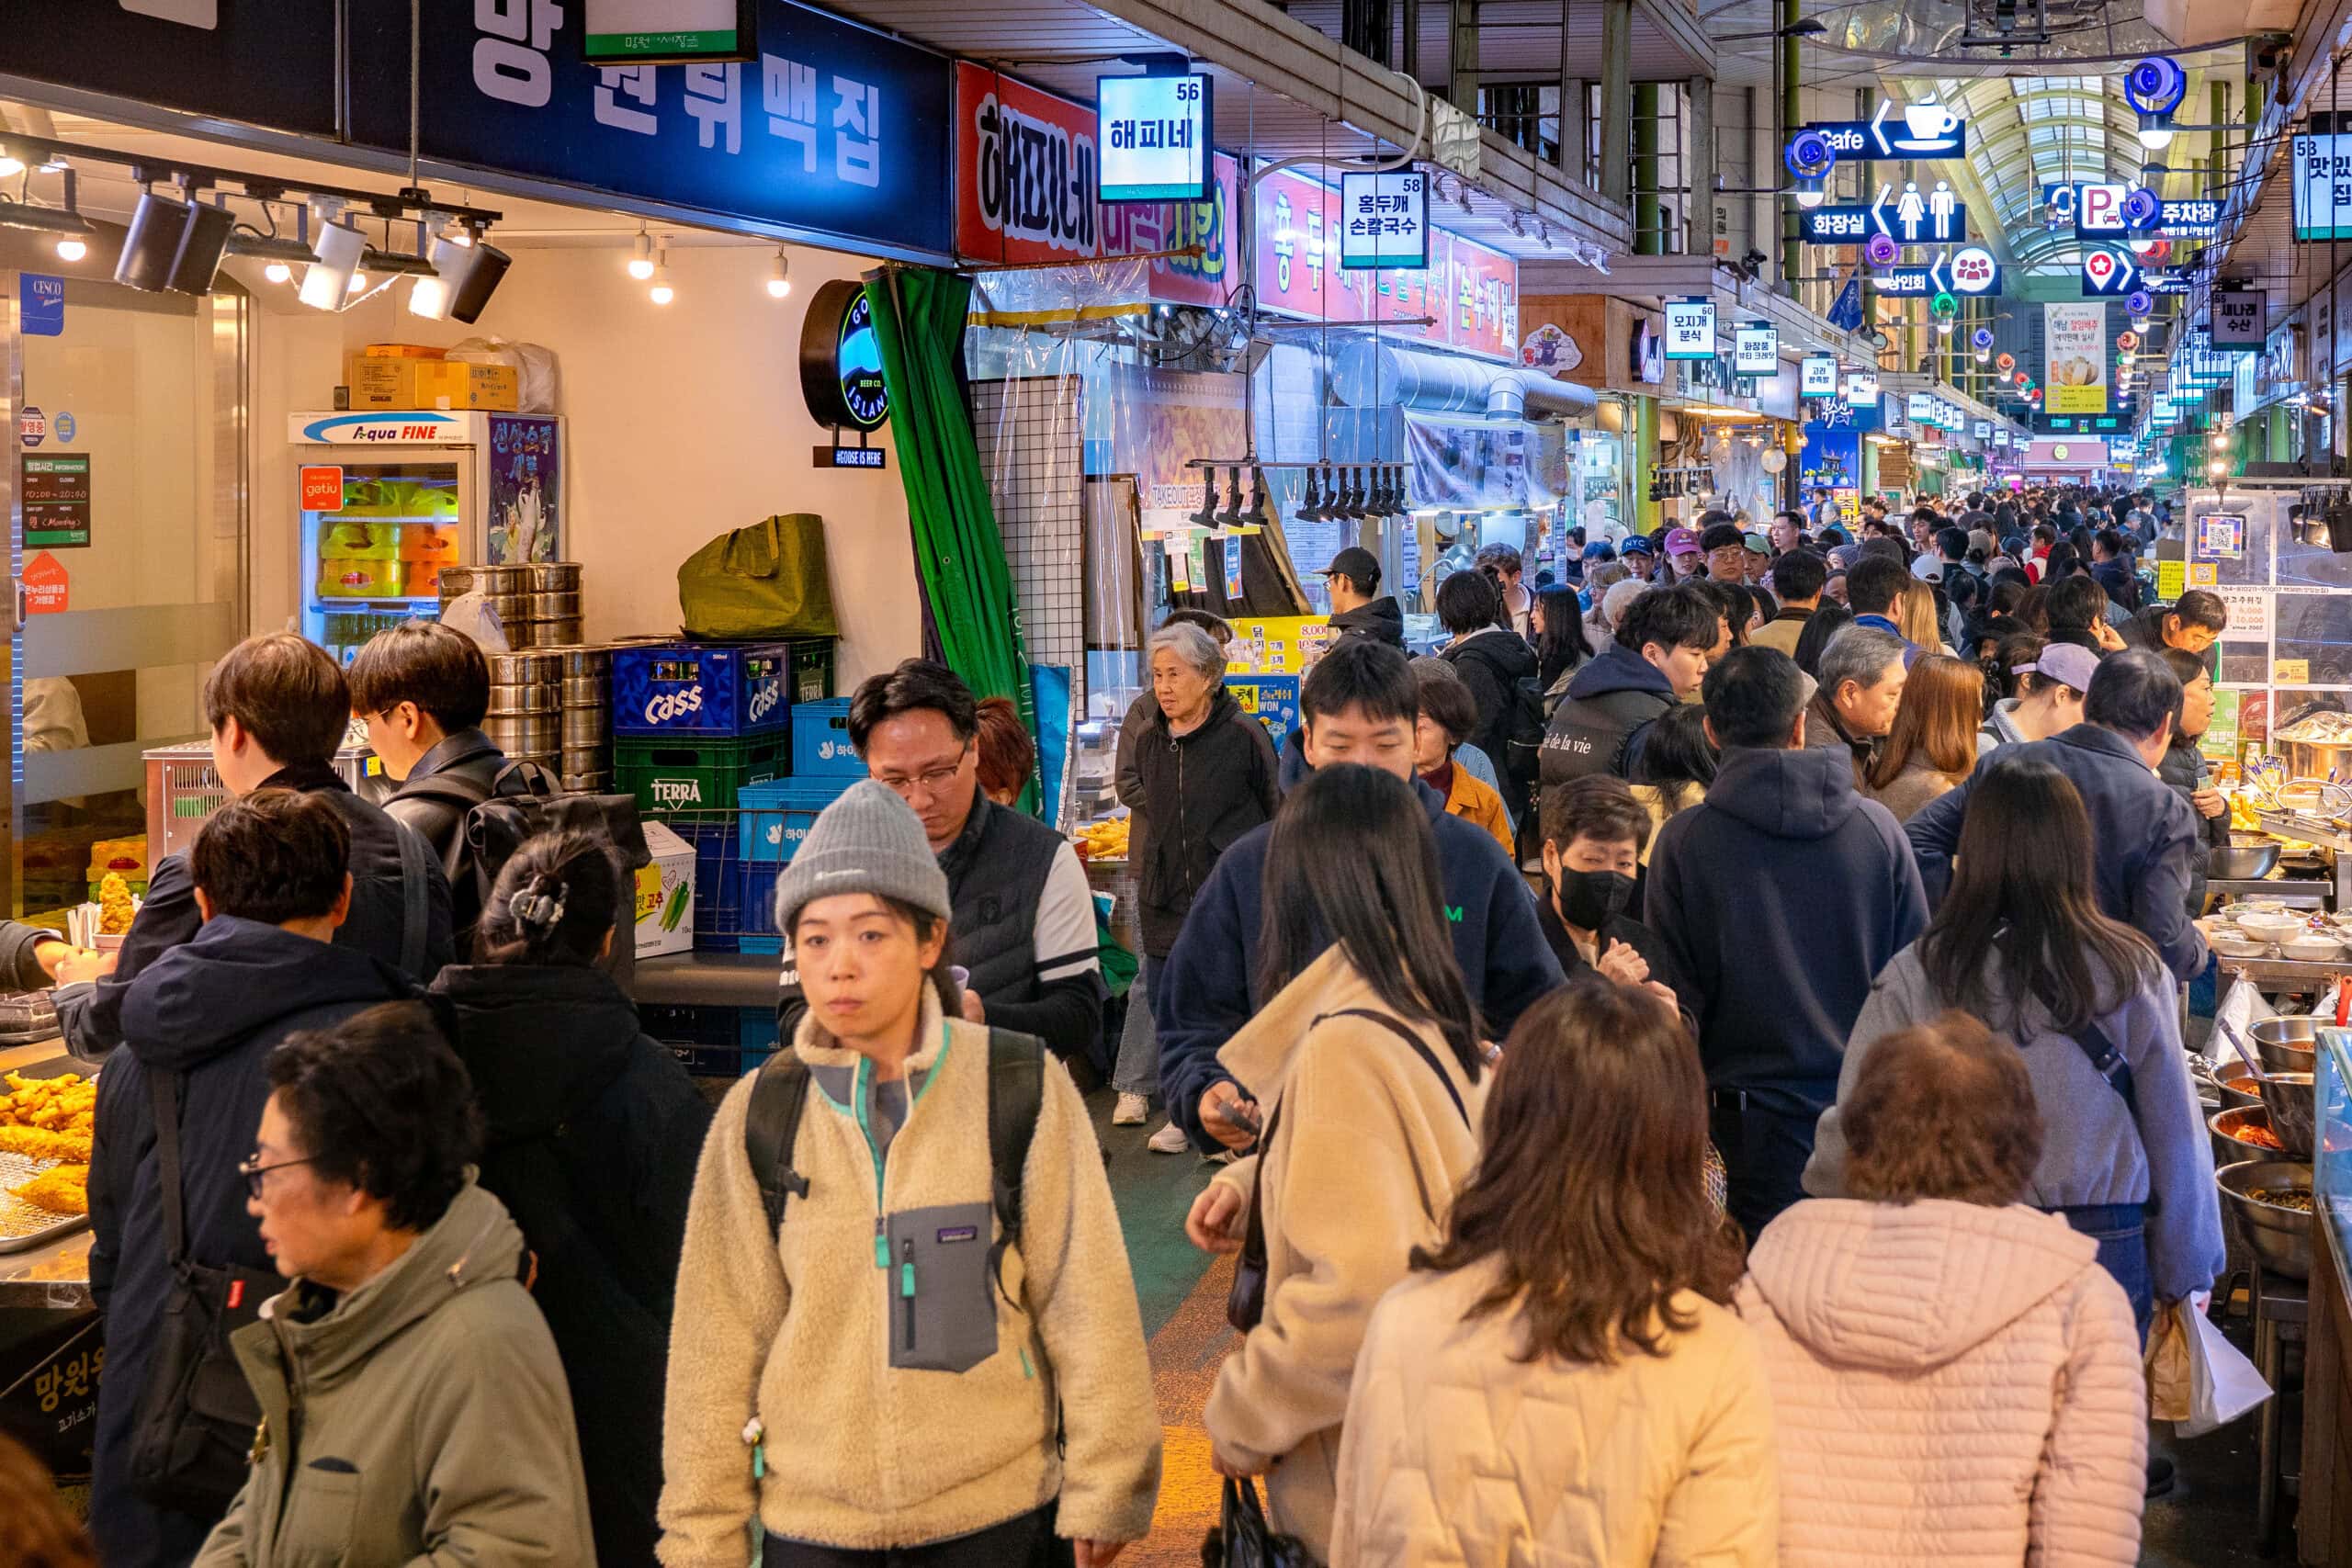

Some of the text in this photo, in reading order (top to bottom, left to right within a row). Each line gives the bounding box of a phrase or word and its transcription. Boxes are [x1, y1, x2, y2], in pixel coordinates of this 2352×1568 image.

[1177, 84, 1198, 100] 56
[1111, 119, 1193, 149] 해피네
[1818, 130, 1864, 150] Cafe
[980, 104, 1094, 248] 해피네
[1403, 179, 1420, 192] 58
[1358, 195, 1408, 212] 홍두깨
[2335, 184, 2351, 206] 집
[2088, 189, 2111, 224] P
[2162, 203, 2217, 223] 주차장
[1350, 218, 1417, 236] 손칼국수
[1814, 214, 1865, 234] 화장실
[33, 279, 62, 295] CESCO
[1888, 274, 1926, 290] 상인회
[1702, 307, 1713, 315] 60
[2221, 303, 2256, 316] 새나래
[2227, 321, 2251, 332] 수산
[1679, 331, 1701, 342] 분식
[1744, 342, 1770, 351] 화장품
[860, 378, 873, 389] BEER
[353, 425, 437, 441] Aqua FINE
[860, 451, 865, 465] IS
[866, 451, 881, 465] HERE
[1152, 485, 1187, 505] TAKEOUT
[799, 682, 823, 702] TERRA
[1259, 701, 1280, 712] WON
[1560, 734, 1571, 750] la
[1574, 736, 1591, 754] vie
[650, 782, 702, 803] TERRA
[646, 891, 663, 909] 고추
